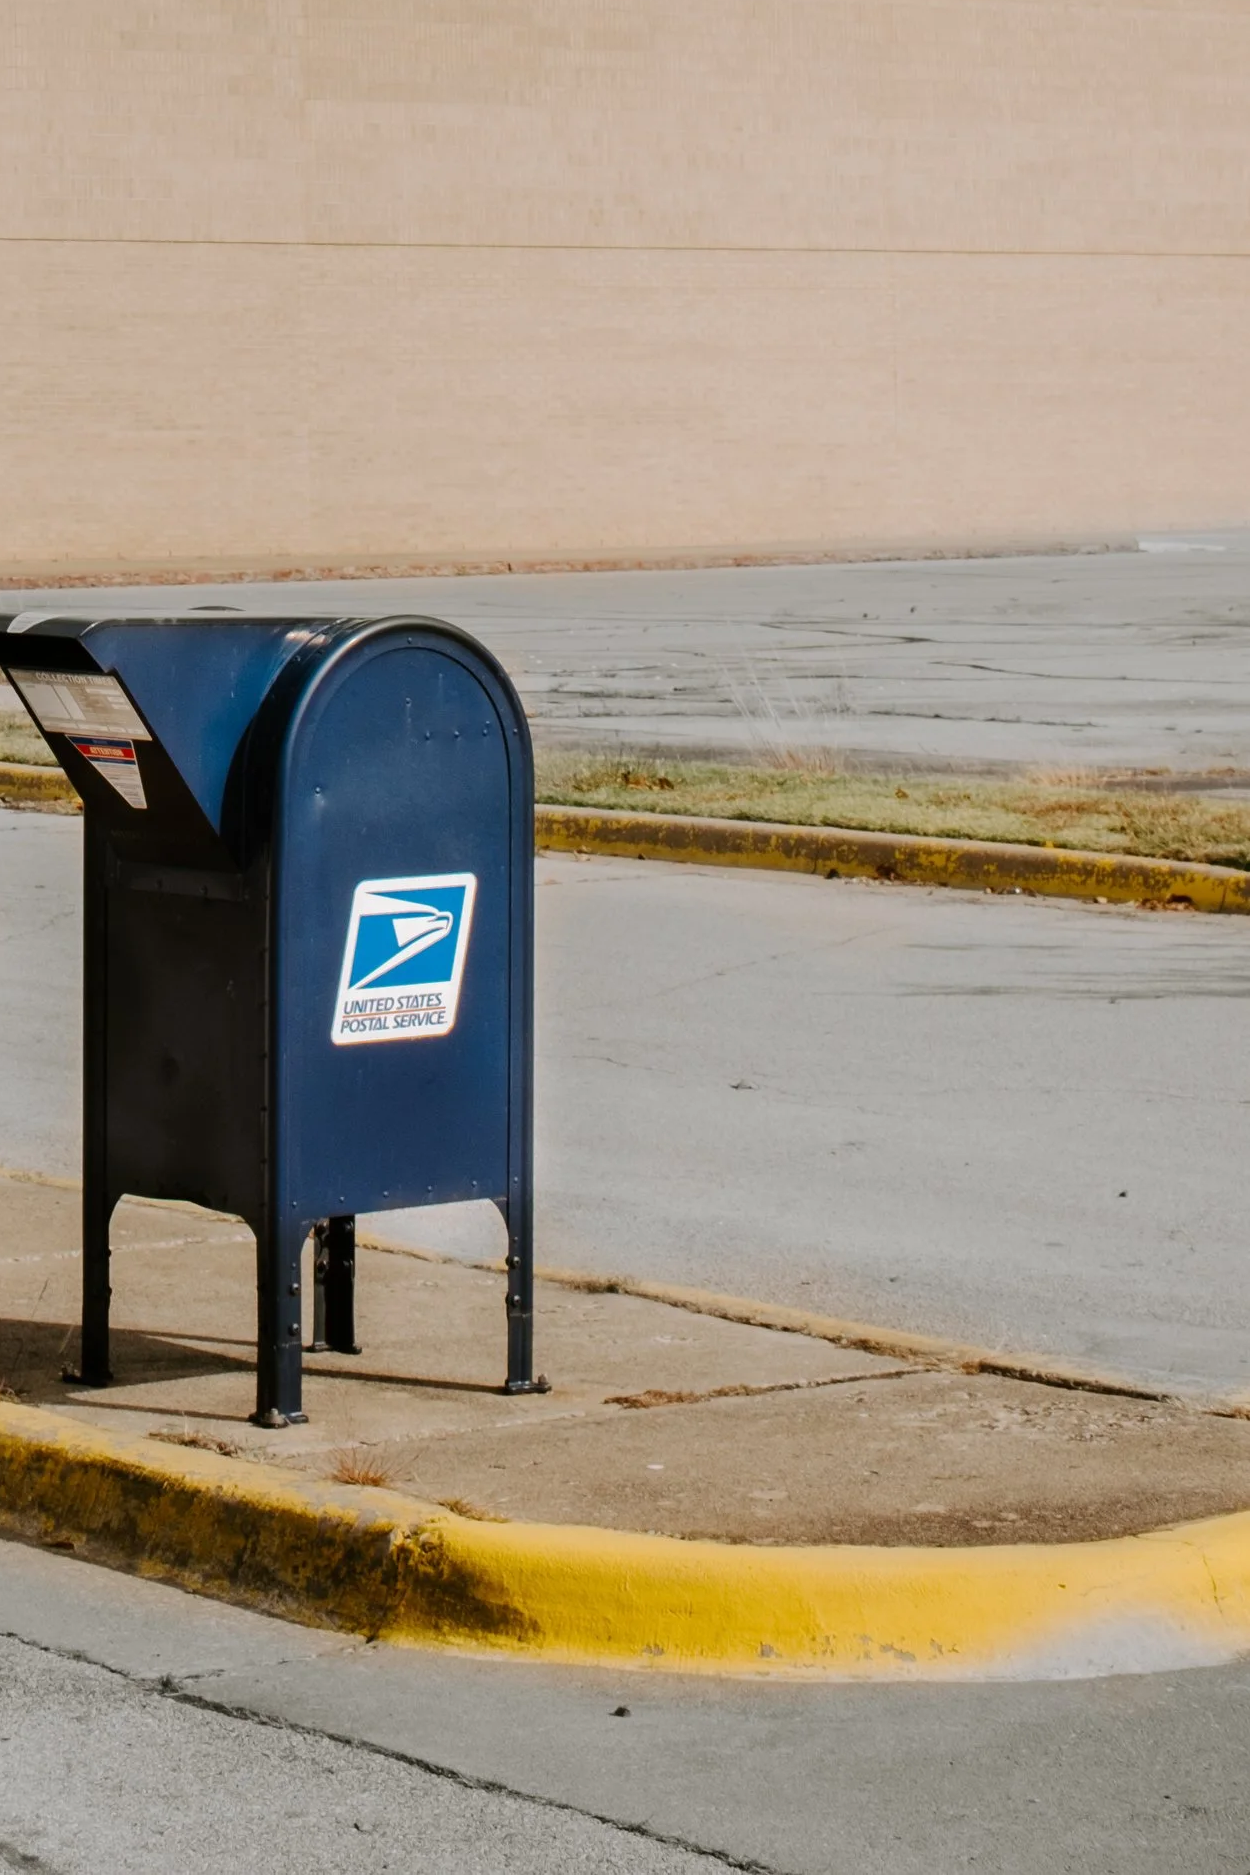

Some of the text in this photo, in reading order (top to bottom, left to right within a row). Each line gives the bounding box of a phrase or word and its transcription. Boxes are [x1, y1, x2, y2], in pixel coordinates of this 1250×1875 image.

[36, 672, 87, 684] COLLECTION
[89, 746, 124, 757] ATTENTION
[343, 992, 442, 1015] UNITED STATES
[340, 1016, 390, 1034] POSTAL
